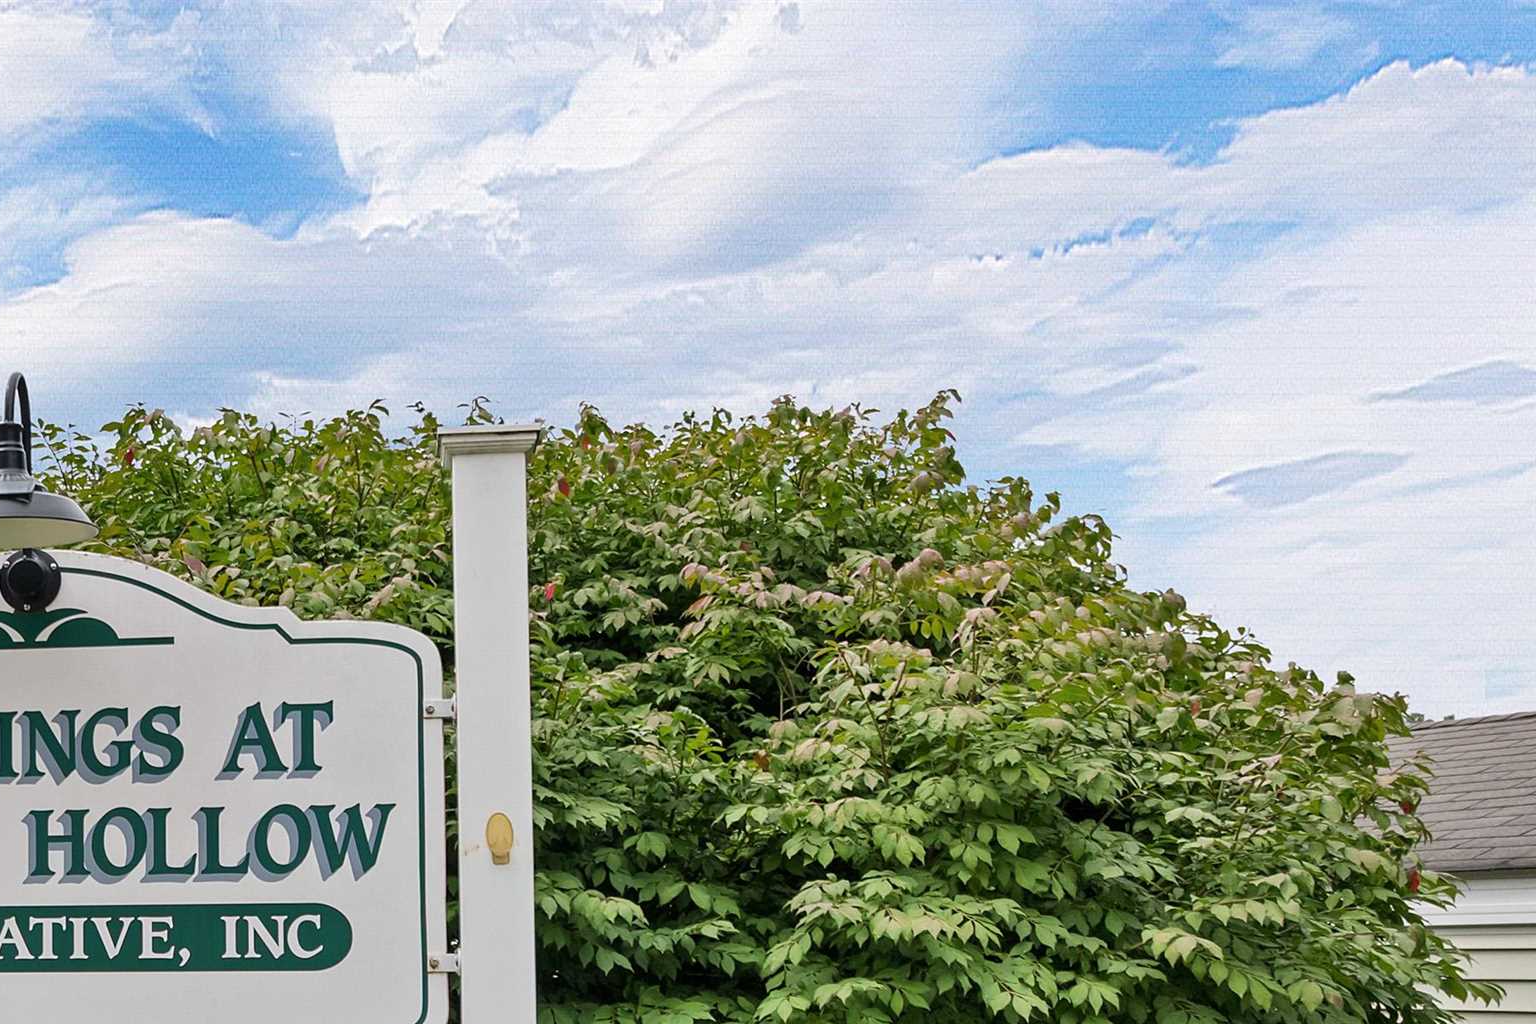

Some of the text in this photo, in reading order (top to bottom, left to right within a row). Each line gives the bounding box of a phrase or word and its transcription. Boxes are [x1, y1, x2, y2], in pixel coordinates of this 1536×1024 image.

[214, 700, 334, 781] AT
[21, 803, 397, 884] HOLLOW
[221, 914, 322, 960] INC
